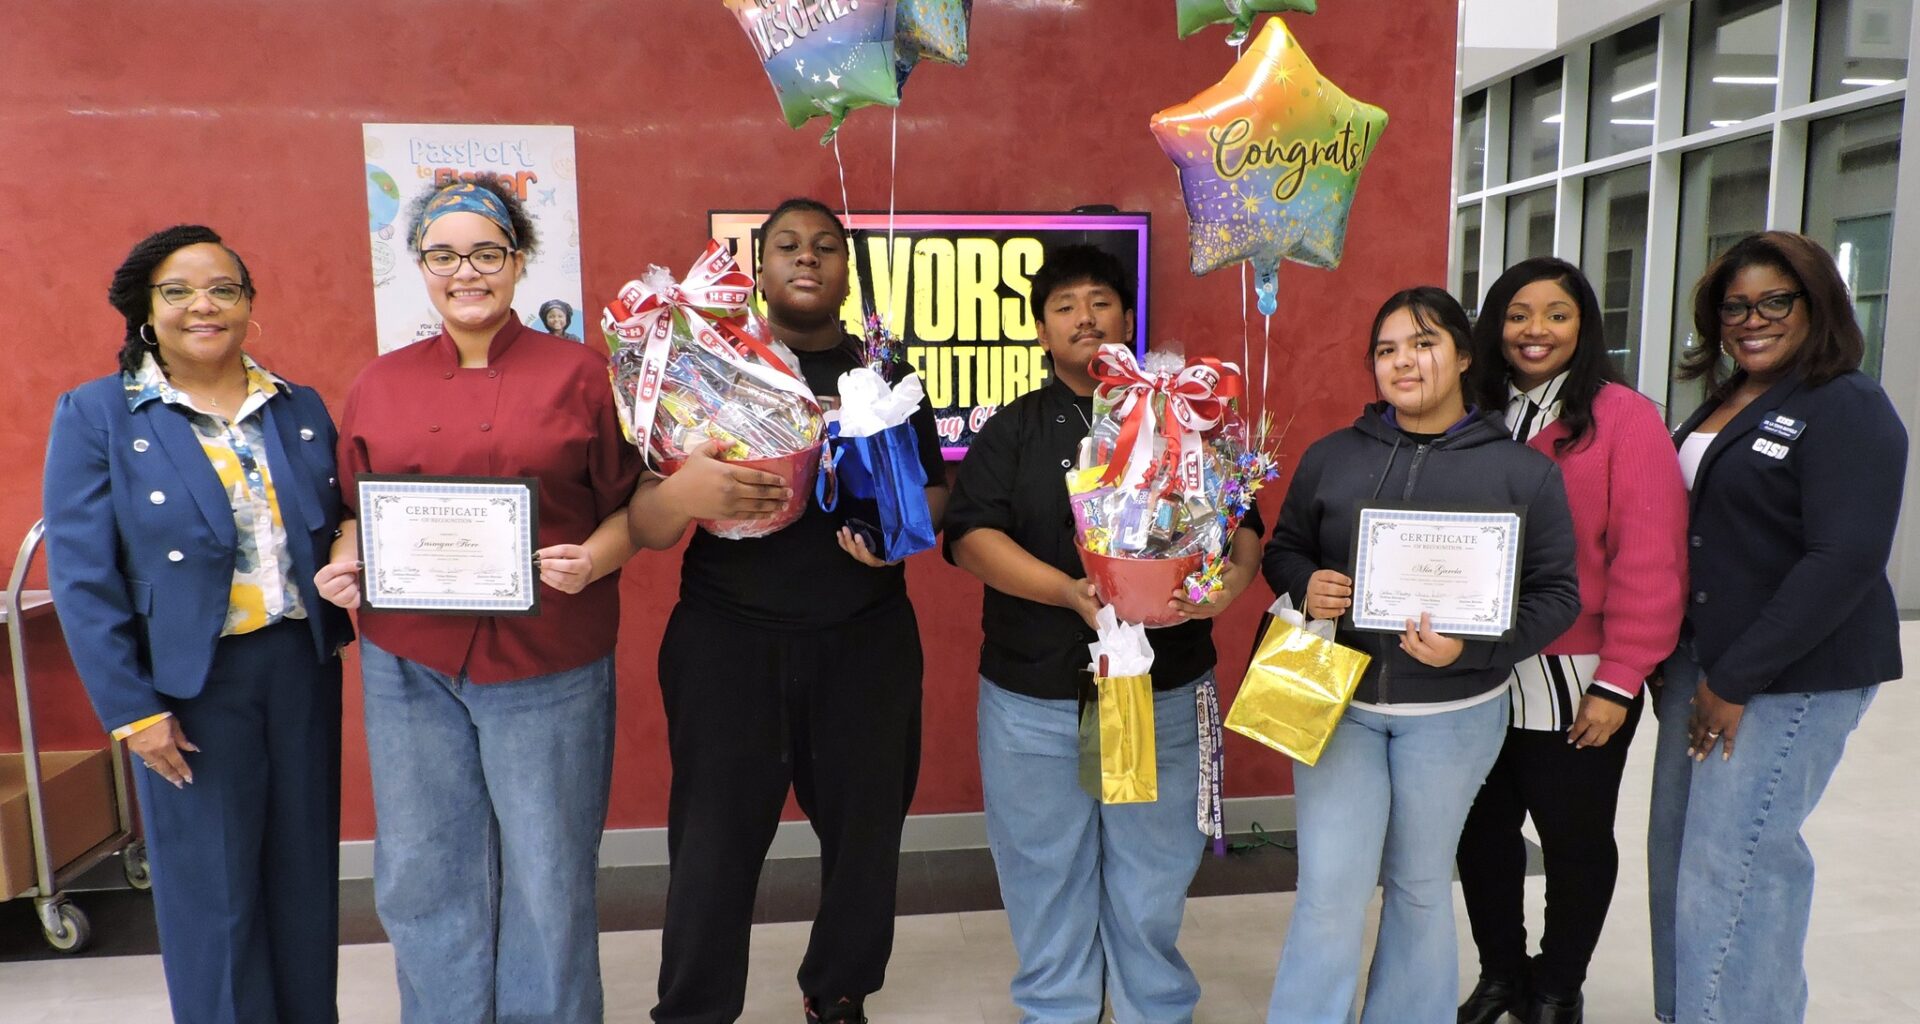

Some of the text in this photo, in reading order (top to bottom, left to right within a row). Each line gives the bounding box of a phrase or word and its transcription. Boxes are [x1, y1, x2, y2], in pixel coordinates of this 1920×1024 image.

[1210, 119, 1370, 201] Congrats!
[406, 506, 488, 517] CERTIFICATE
[1400, 533, 1478, 545] CERTIFICATE
